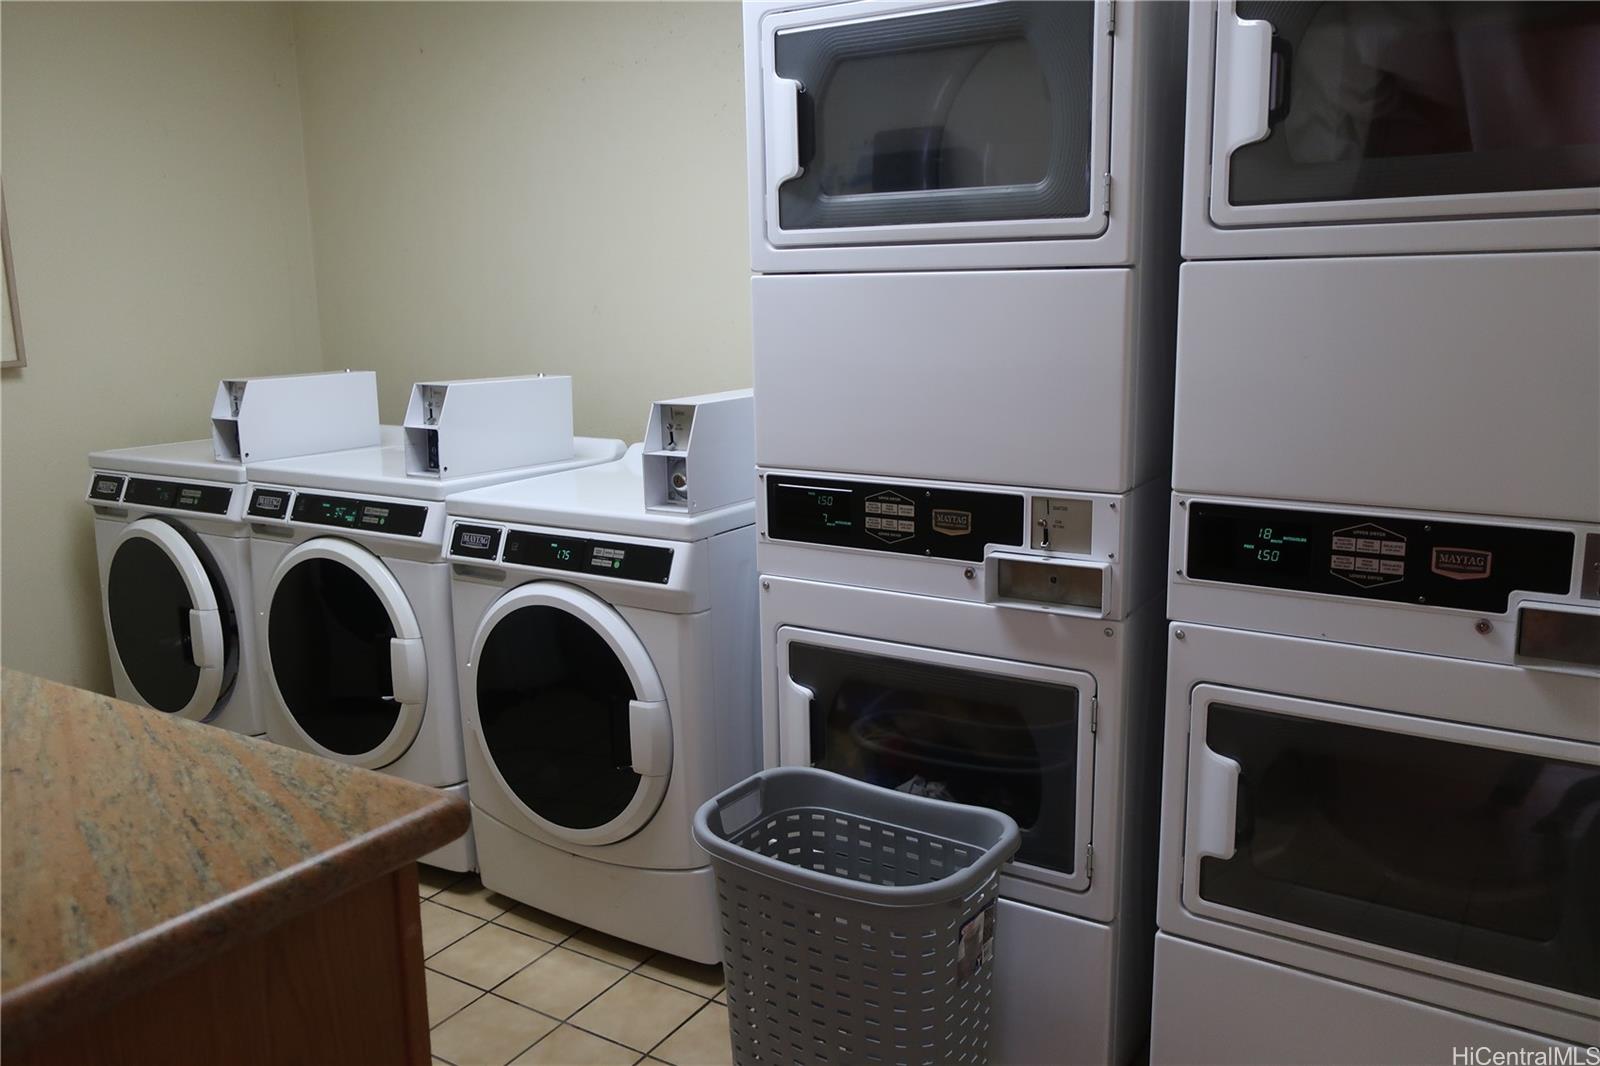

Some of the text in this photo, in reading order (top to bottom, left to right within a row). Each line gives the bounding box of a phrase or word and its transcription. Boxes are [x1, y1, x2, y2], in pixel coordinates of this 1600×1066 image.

[936, 514, 967, 525] MAYTAG
[463, 534, 489, 544] MAYTAG
[1258, 528, 1272, 539] 18
[1439, 553, 1485, 566] MAYTAG
